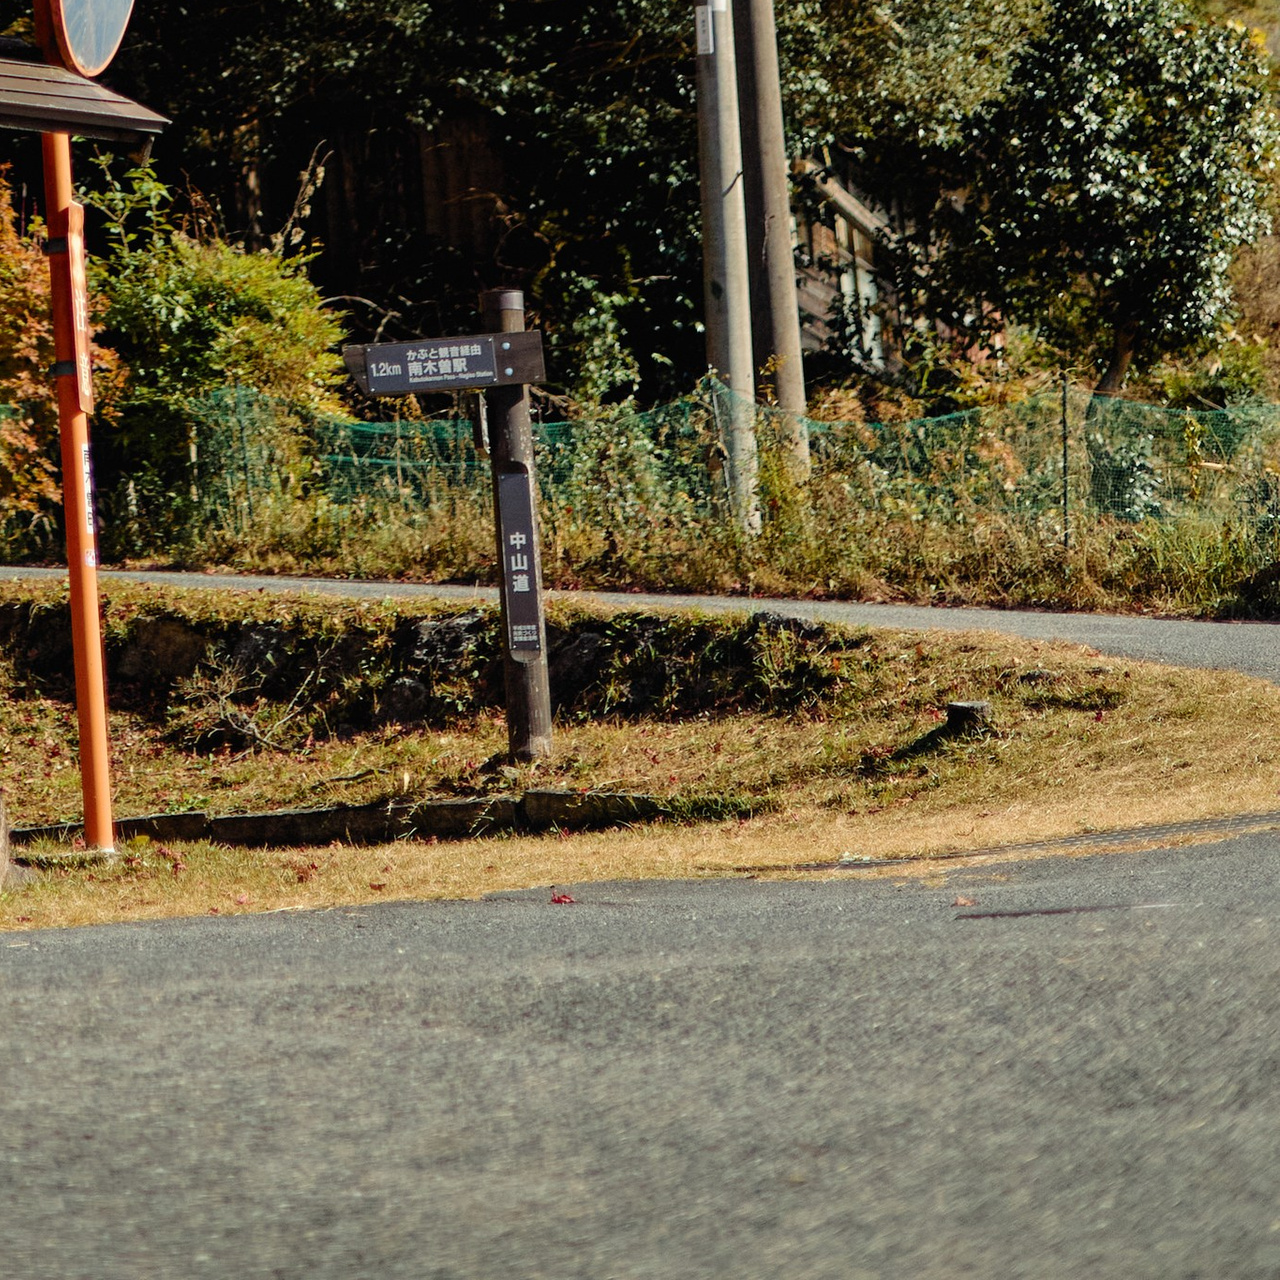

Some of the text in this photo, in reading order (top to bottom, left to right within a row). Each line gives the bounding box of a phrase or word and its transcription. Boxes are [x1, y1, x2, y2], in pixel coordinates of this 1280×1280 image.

[406, 343, 482, 361] かぶと観音経由
[370, 362, 402, 378] 1.2km
[407, 357, 468, 377] 南木曽駅
[509, 531, 530, 593] 中山道
